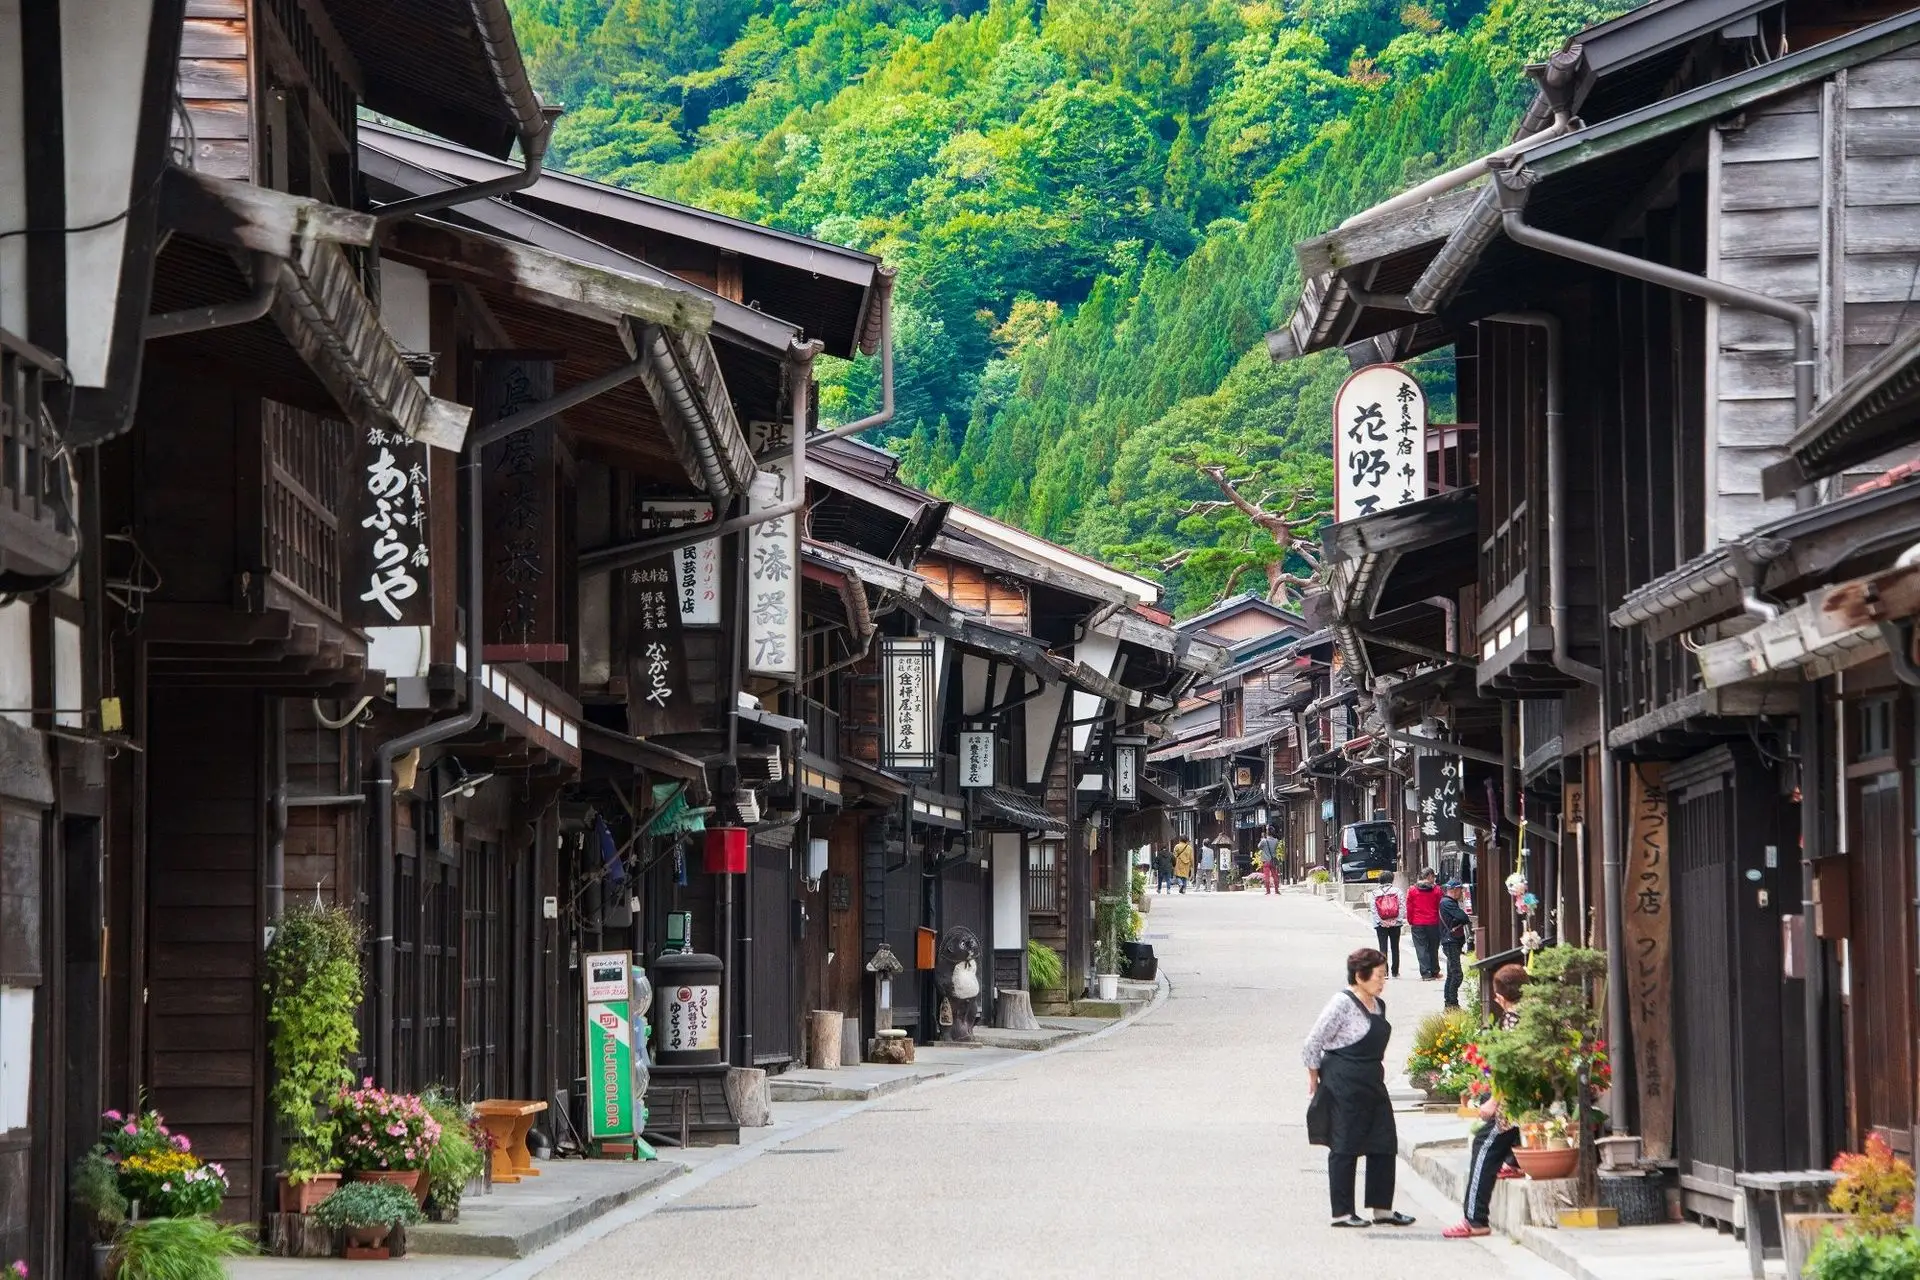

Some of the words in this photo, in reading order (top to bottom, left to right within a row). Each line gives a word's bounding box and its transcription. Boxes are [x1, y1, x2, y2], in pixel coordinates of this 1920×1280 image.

[1396, 382, 1417, 456] 奈良井宿
[360, 447, 418, 621] あぶらや
[408, 462, 429, 568] 奈良井宿
[631, 568, 669, 584] 奈良井宿
[646, 642, 672, 709] ながとや
[1634, 784, 1668, 916] 手づくりの店
[1636, 937, 1658, 1024] フレンド
[603, 1032, 619, 1128] FUJICOLOR
